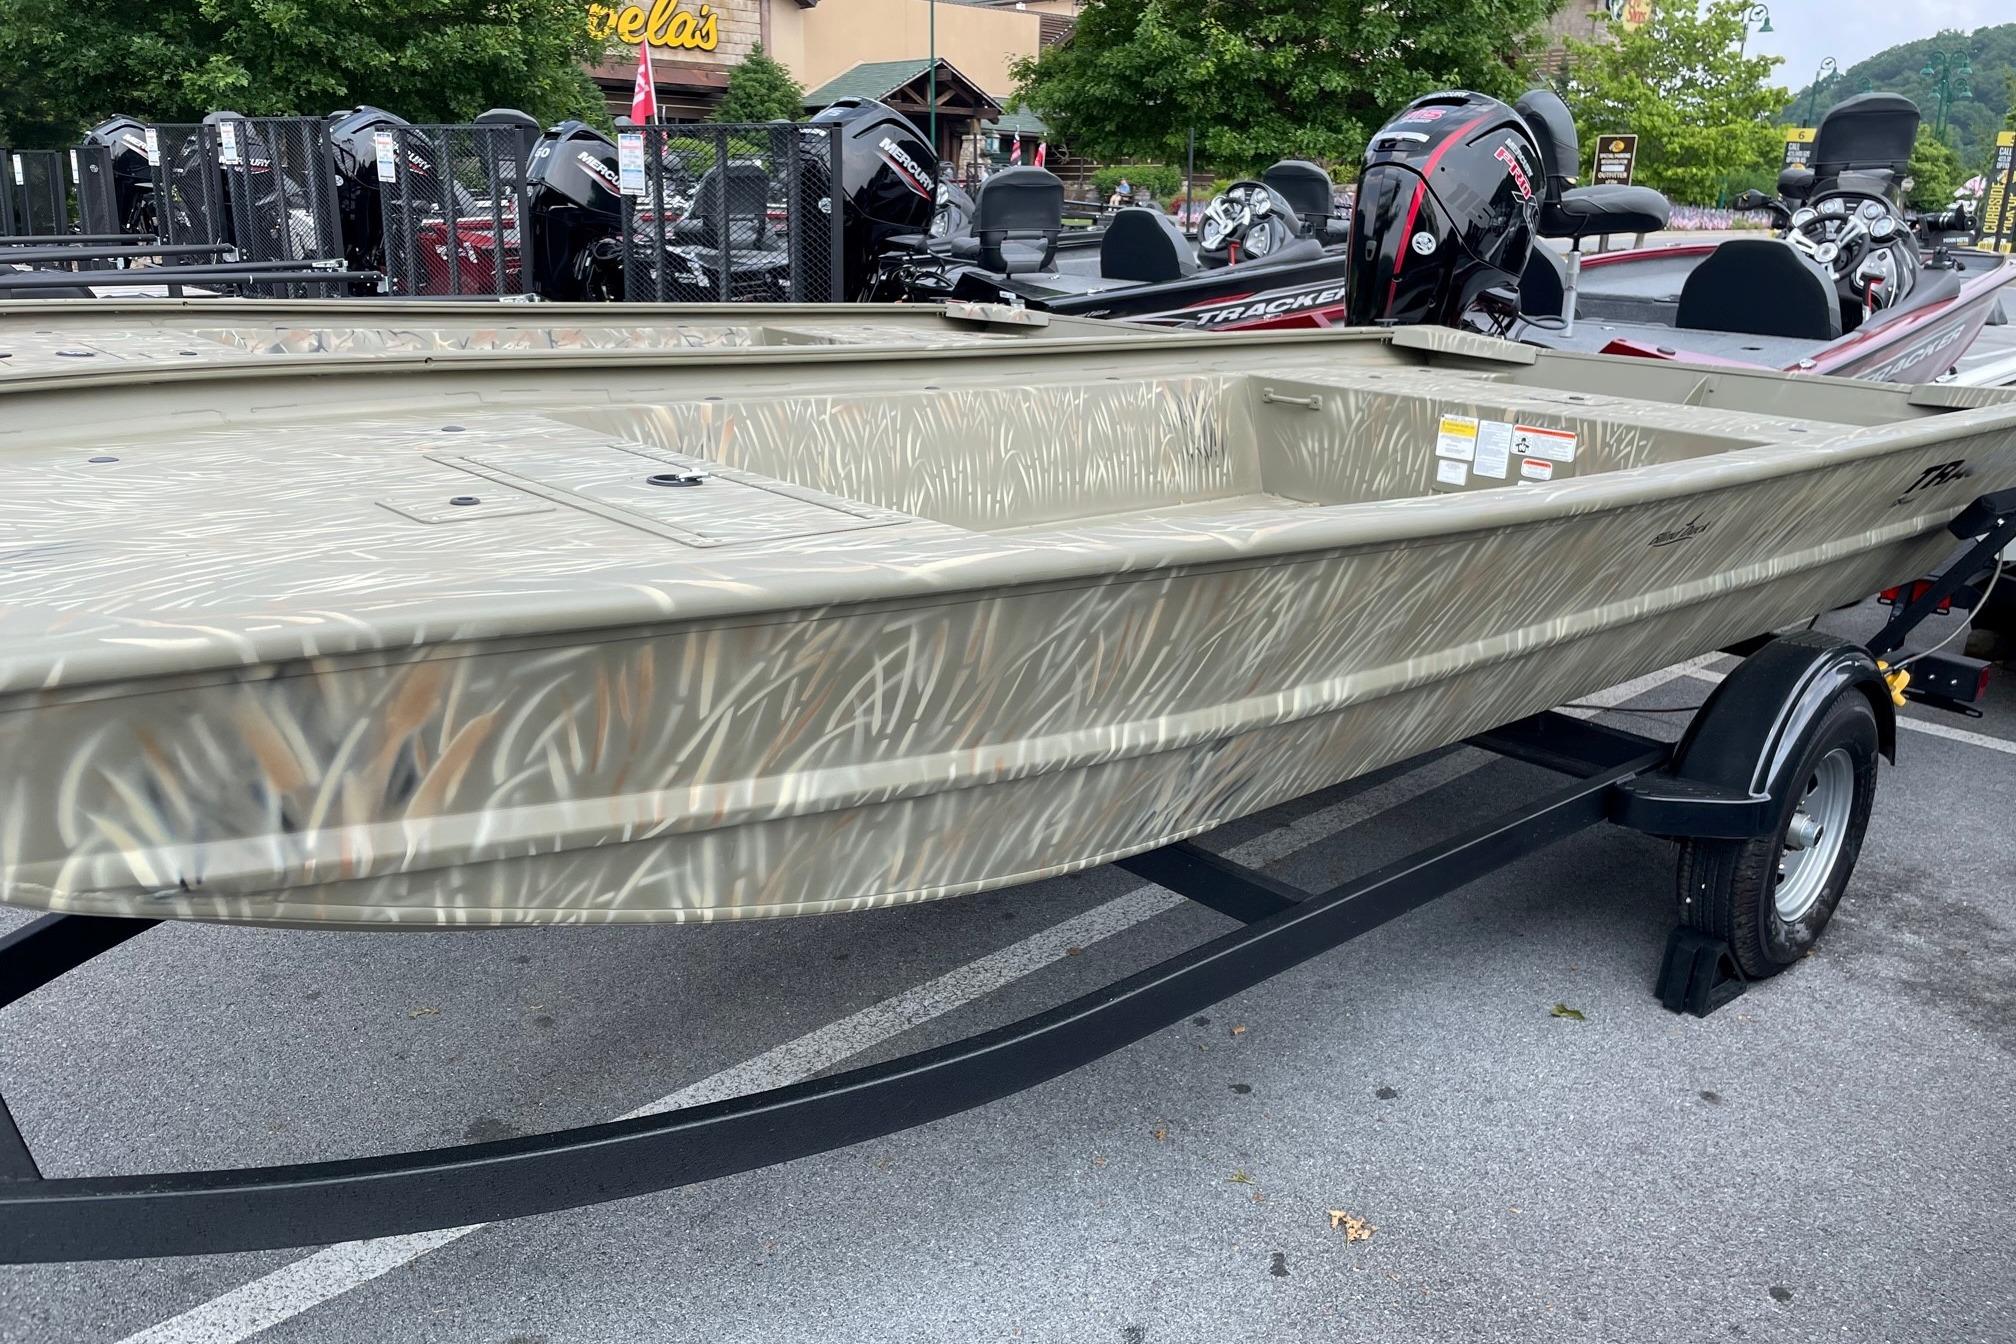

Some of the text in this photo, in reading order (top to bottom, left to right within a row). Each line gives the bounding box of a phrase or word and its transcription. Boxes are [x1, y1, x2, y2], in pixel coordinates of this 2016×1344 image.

[1798, 131, 1805, 140] 6
[577, 151, 621, 188] MERCU
[878, 137, 935, 192] MERCURY
[1983, 181, 2006, 234] CURBSIDE
